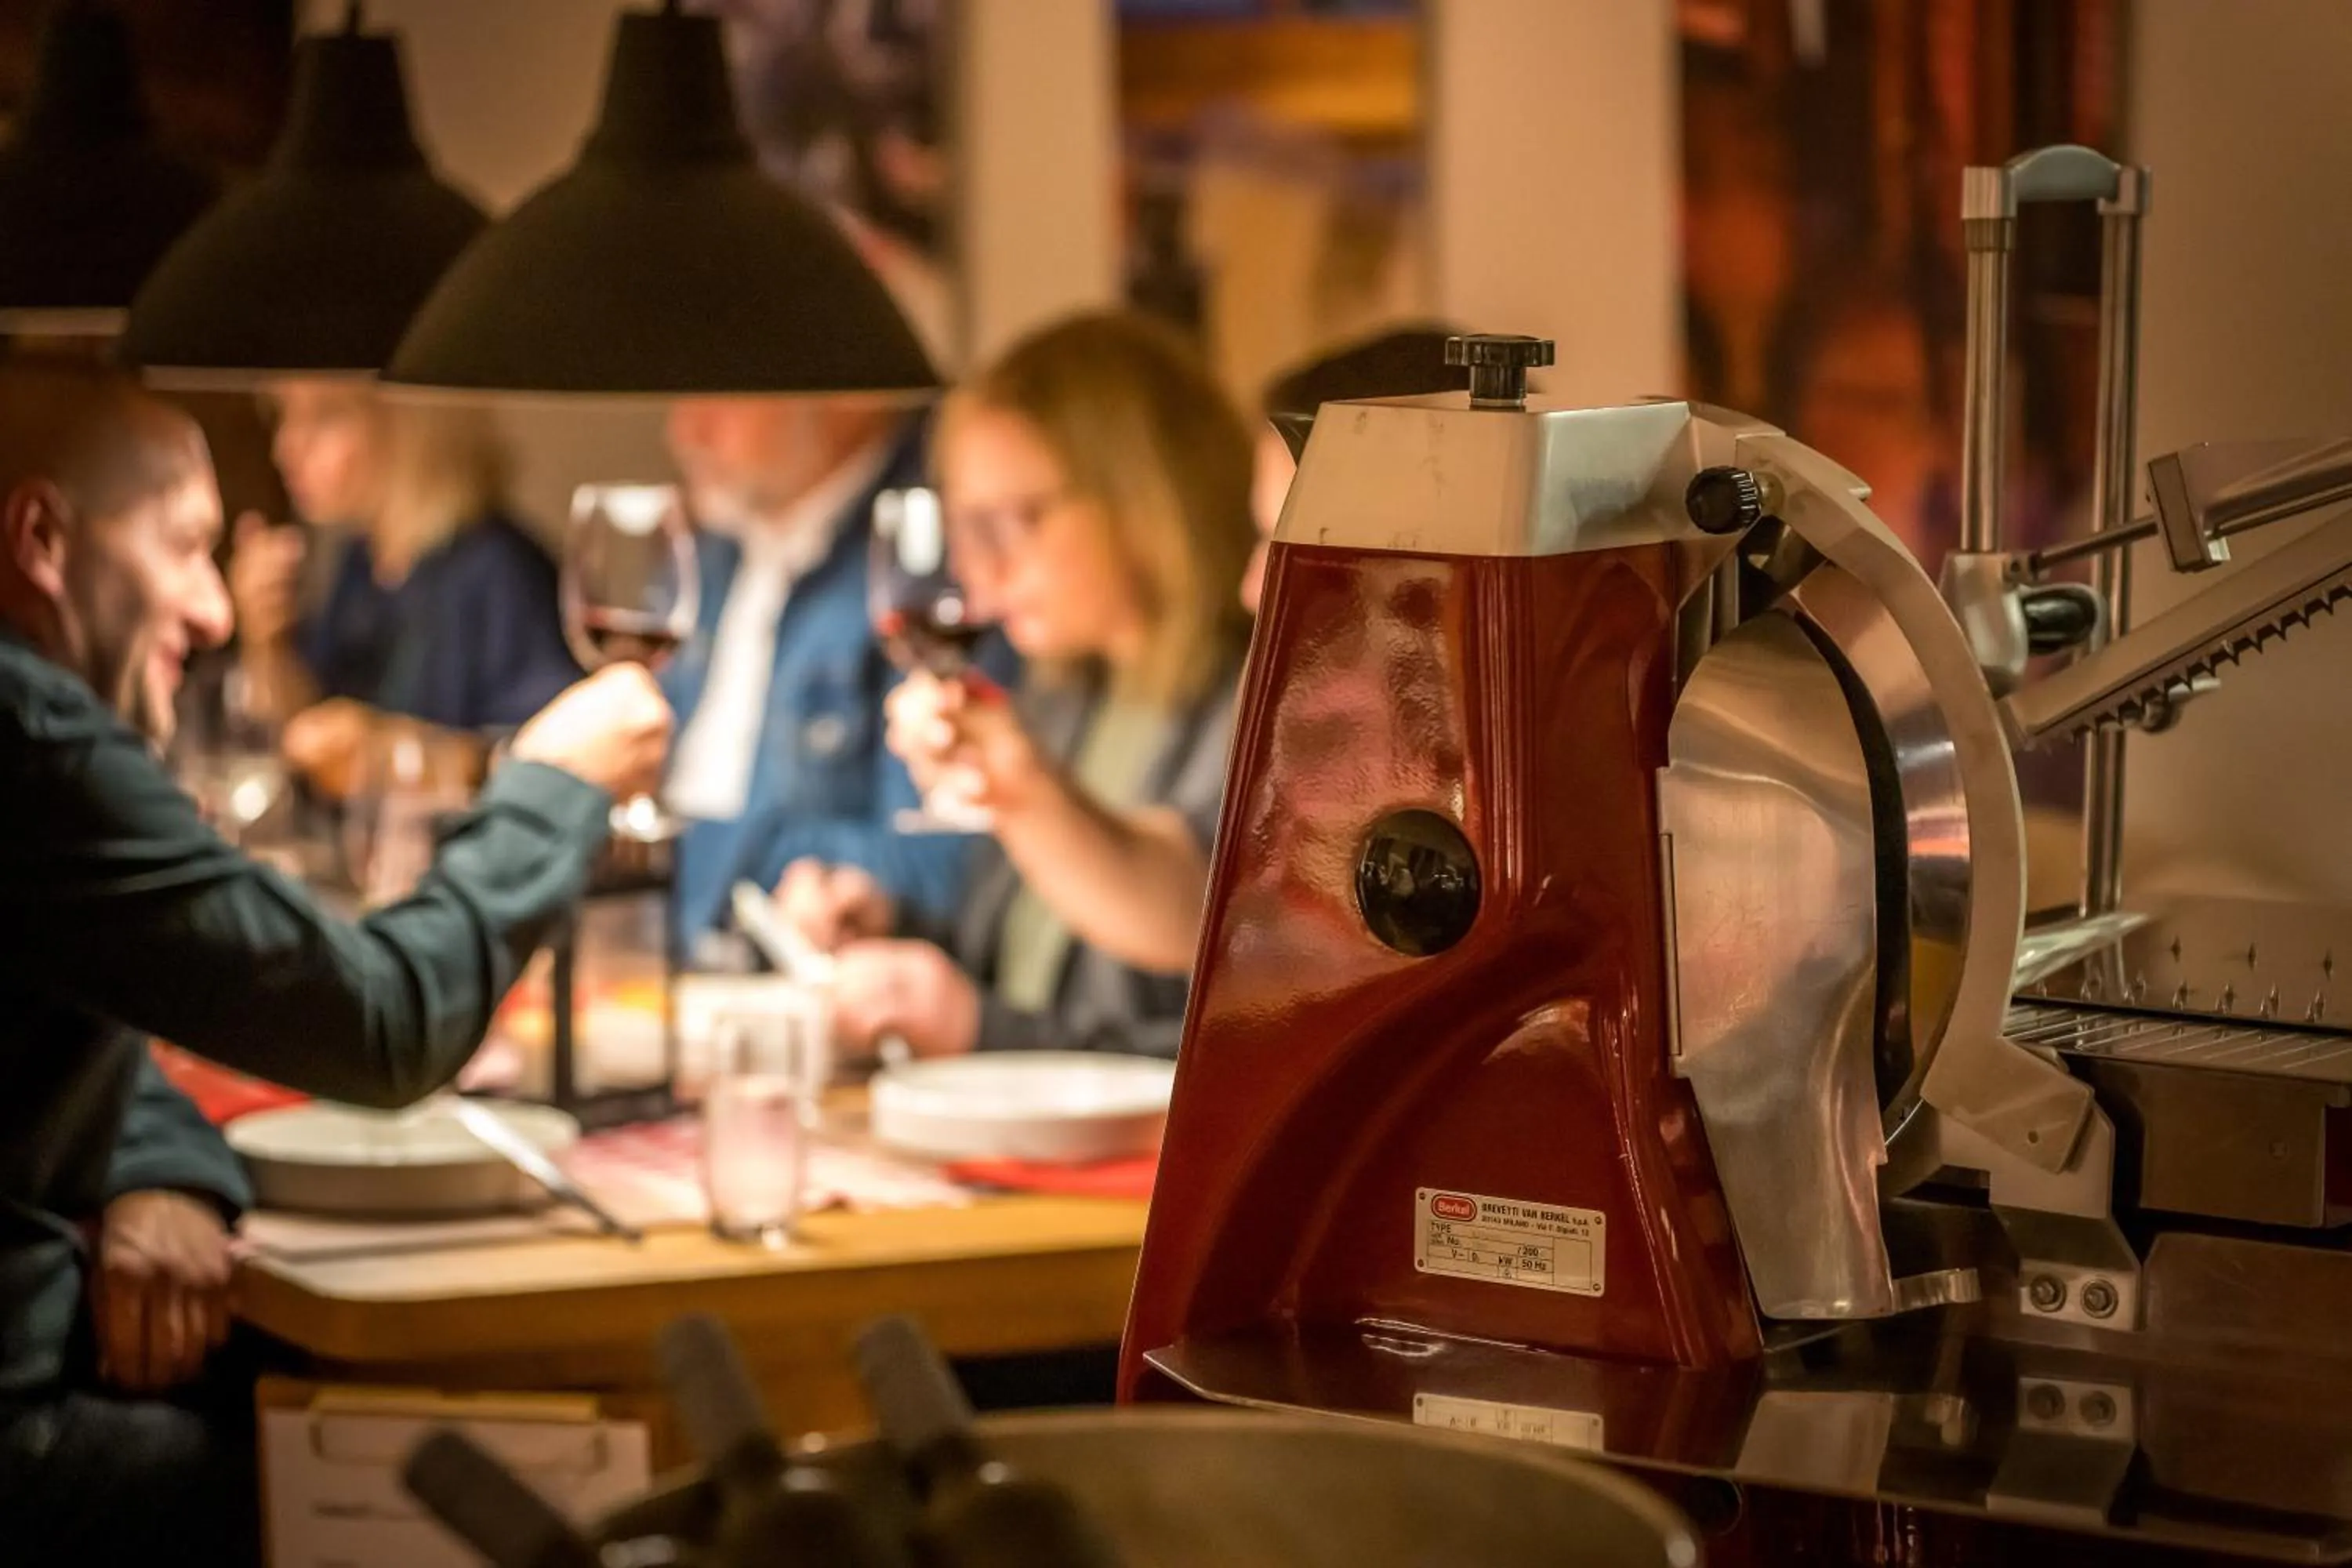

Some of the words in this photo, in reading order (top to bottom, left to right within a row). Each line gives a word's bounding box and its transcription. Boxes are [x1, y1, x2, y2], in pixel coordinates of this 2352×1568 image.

[1437, 1201, 1470, 1215] Berkel
[1482, 1203, 1519, 1216] BREVETTI
[1522, 1208, 1537, 1219] VAN
[1541, 1210, 1570, 1224] BERKEL
[1431, 1222, 1451, 1233] TYPE
[1522, 1259, 1533, 1268] 50
